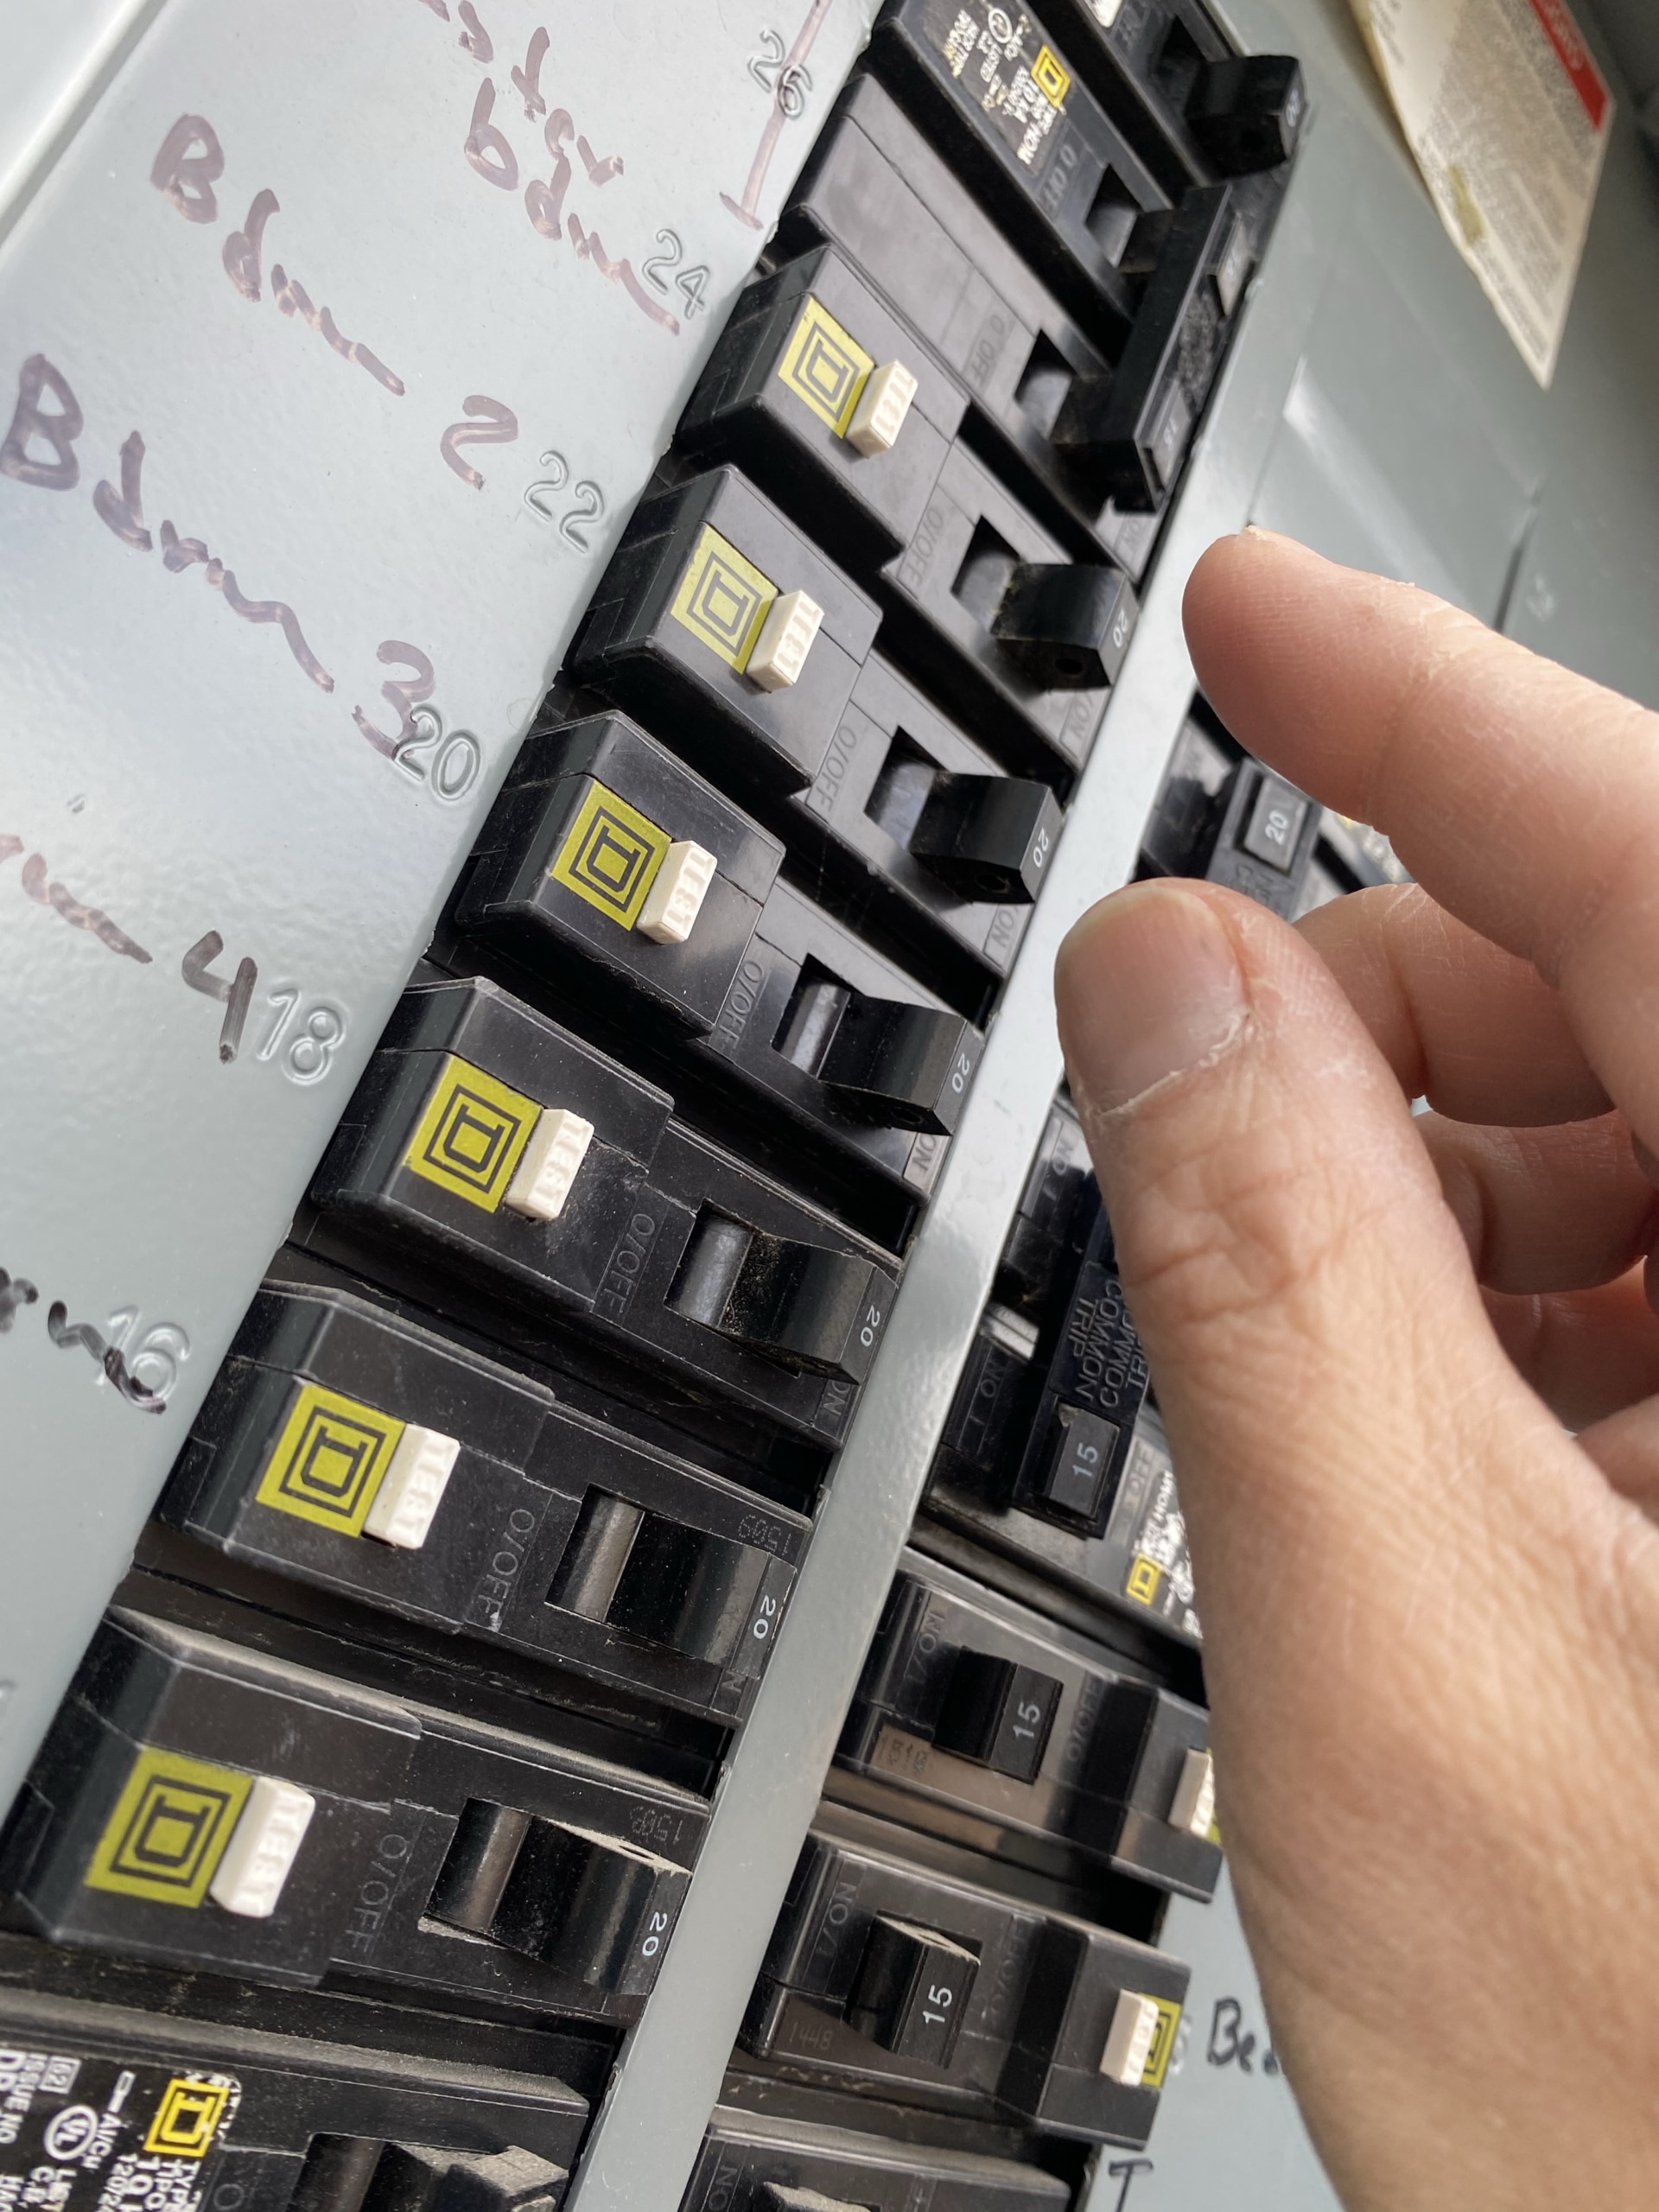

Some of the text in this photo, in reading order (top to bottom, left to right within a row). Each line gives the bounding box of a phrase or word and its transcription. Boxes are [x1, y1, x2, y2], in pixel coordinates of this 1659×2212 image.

[747, 29, 814, 120] 26
[641, 228, 710, 320] 24
[440, 394, 519, 490] 2
[524, 449, 606, 554] 22
[1113, 608, 1128, 648] 20
[350, 639, 435, 762] 3
[393, 702, 481, 802] 20
[1033, 827, 1049, 868] 20
[1264, 809, 1288, 846] 20
[181, 929, 258, 1064] 4
[256, 987, 347, 1087] 18
[951, 1052, 970, 1094] 20
[860, 1305, 880, 1347] 20
[94, 1304, 192, 1402] 16
[1071, 1443, 1099, 1481] 15
[752, 1593, 777, 1640] 20
[1012, 1701, 1041, 1740] 15
[641, 1910, 669, 1957] 20
[921, 1985, 954, 2025] 15
[3, 2053, 48, 2112] ISSUE
